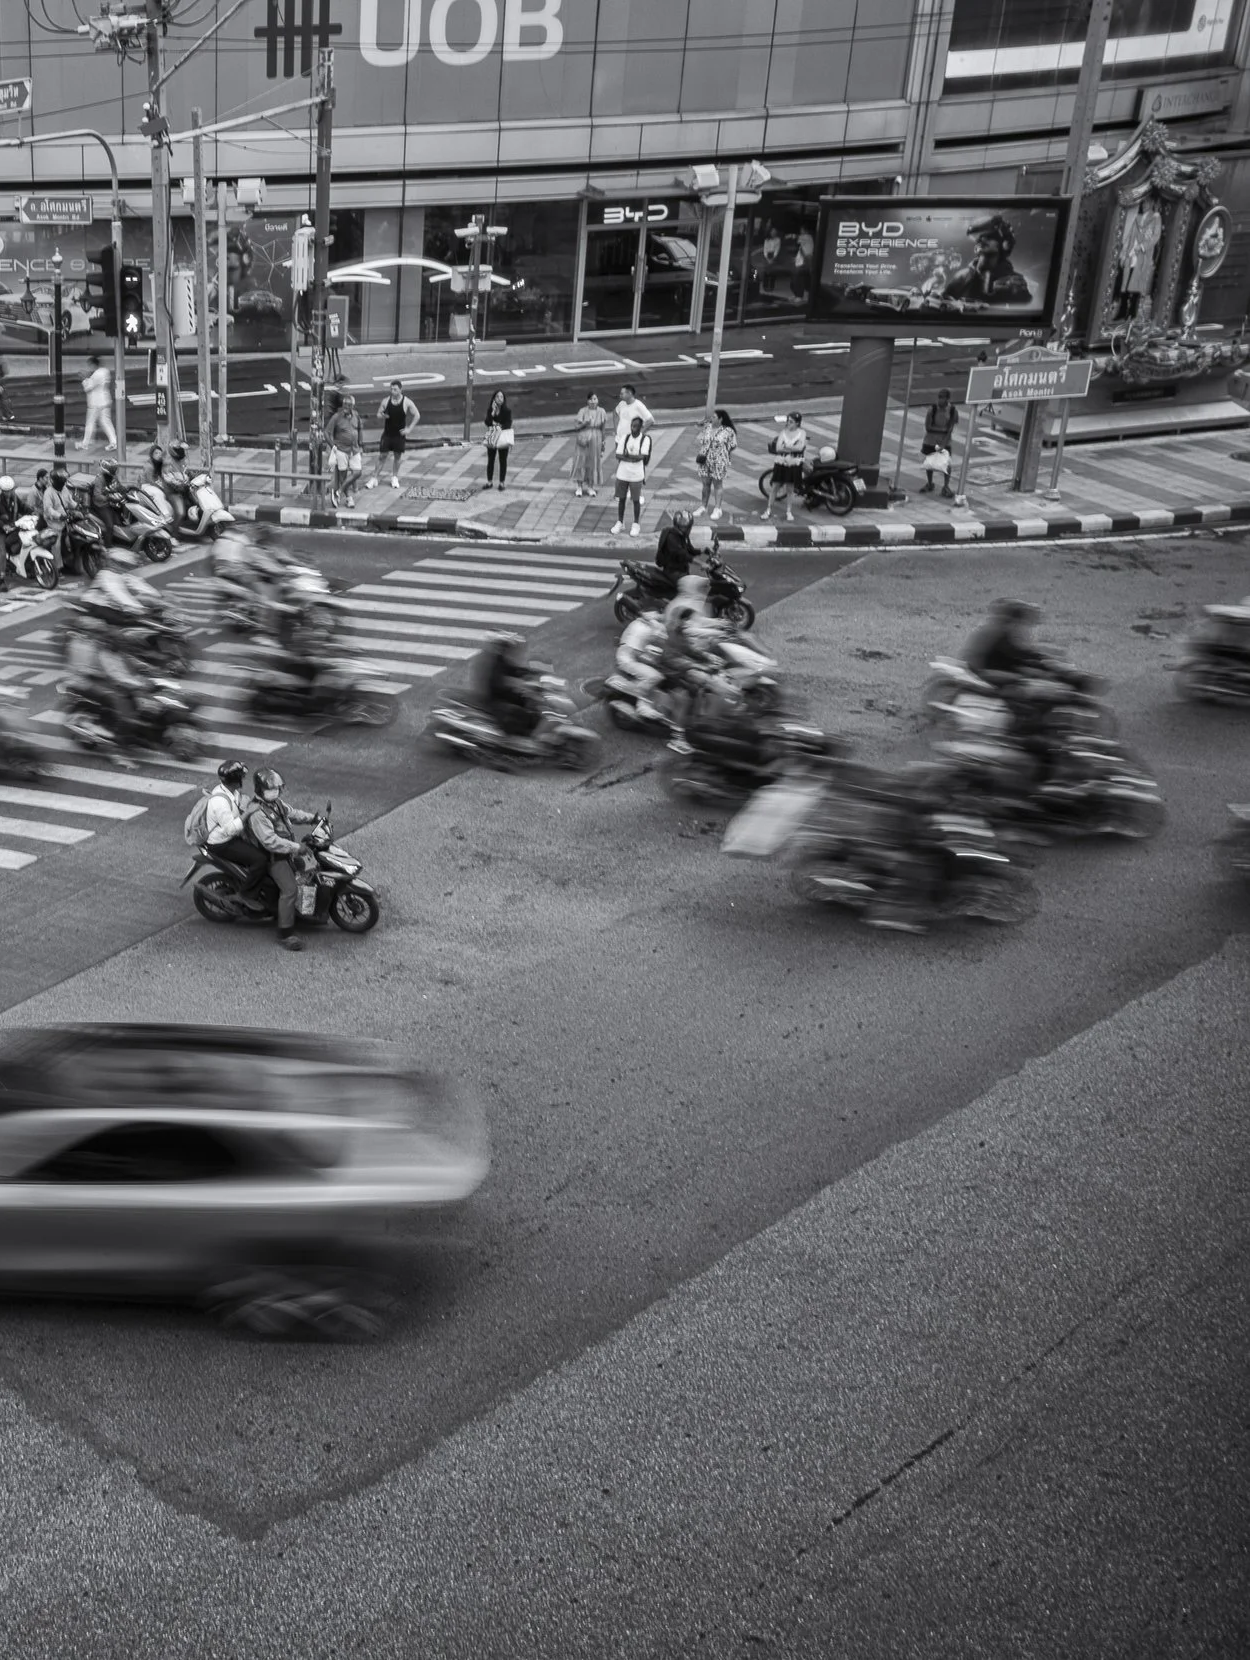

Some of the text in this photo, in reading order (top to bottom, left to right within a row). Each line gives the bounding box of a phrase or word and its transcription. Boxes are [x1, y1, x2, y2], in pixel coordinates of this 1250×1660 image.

[359, 0, 563, 66] UOB
[838, 221, 905, 237] BYD
[836, 238, 940, 248] EXPERIENCE
[835, 247, 891, 257] STORE
[993, 364, 1068, 388] อโศกมนตรี
[1001, 387, 1055, 399] Asok Montri
